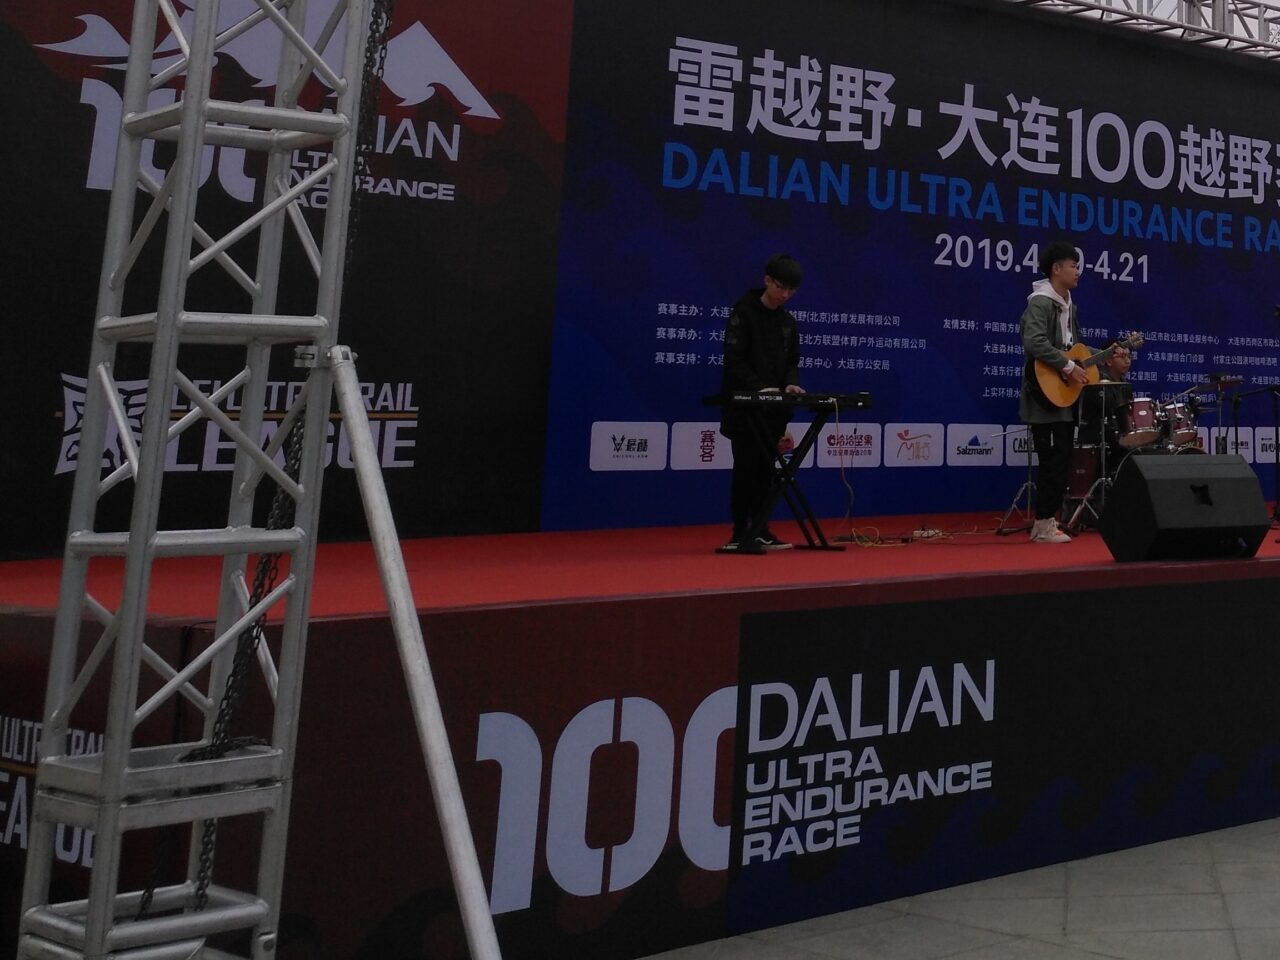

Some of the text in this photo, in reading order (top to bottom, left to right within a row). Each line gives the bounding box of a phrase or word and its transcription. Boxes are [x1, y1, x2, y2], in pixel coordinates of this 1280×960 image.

[662, 141, 851, 206] DALIAN
[867, 166, 1005, 224] ULTRA
[1018, 185, 1234, 250] ENDURANCE
[837, 358, 890, 371] 大连市公安局
[957, 445, 992, 456] Salzmann
[747, 659, 996, 754] DALIAN
[744, 760, 993, 829] ENDURANCE
[745, 744, 883, 793] ULTRA
[742, 814, 861, 866] RACE
